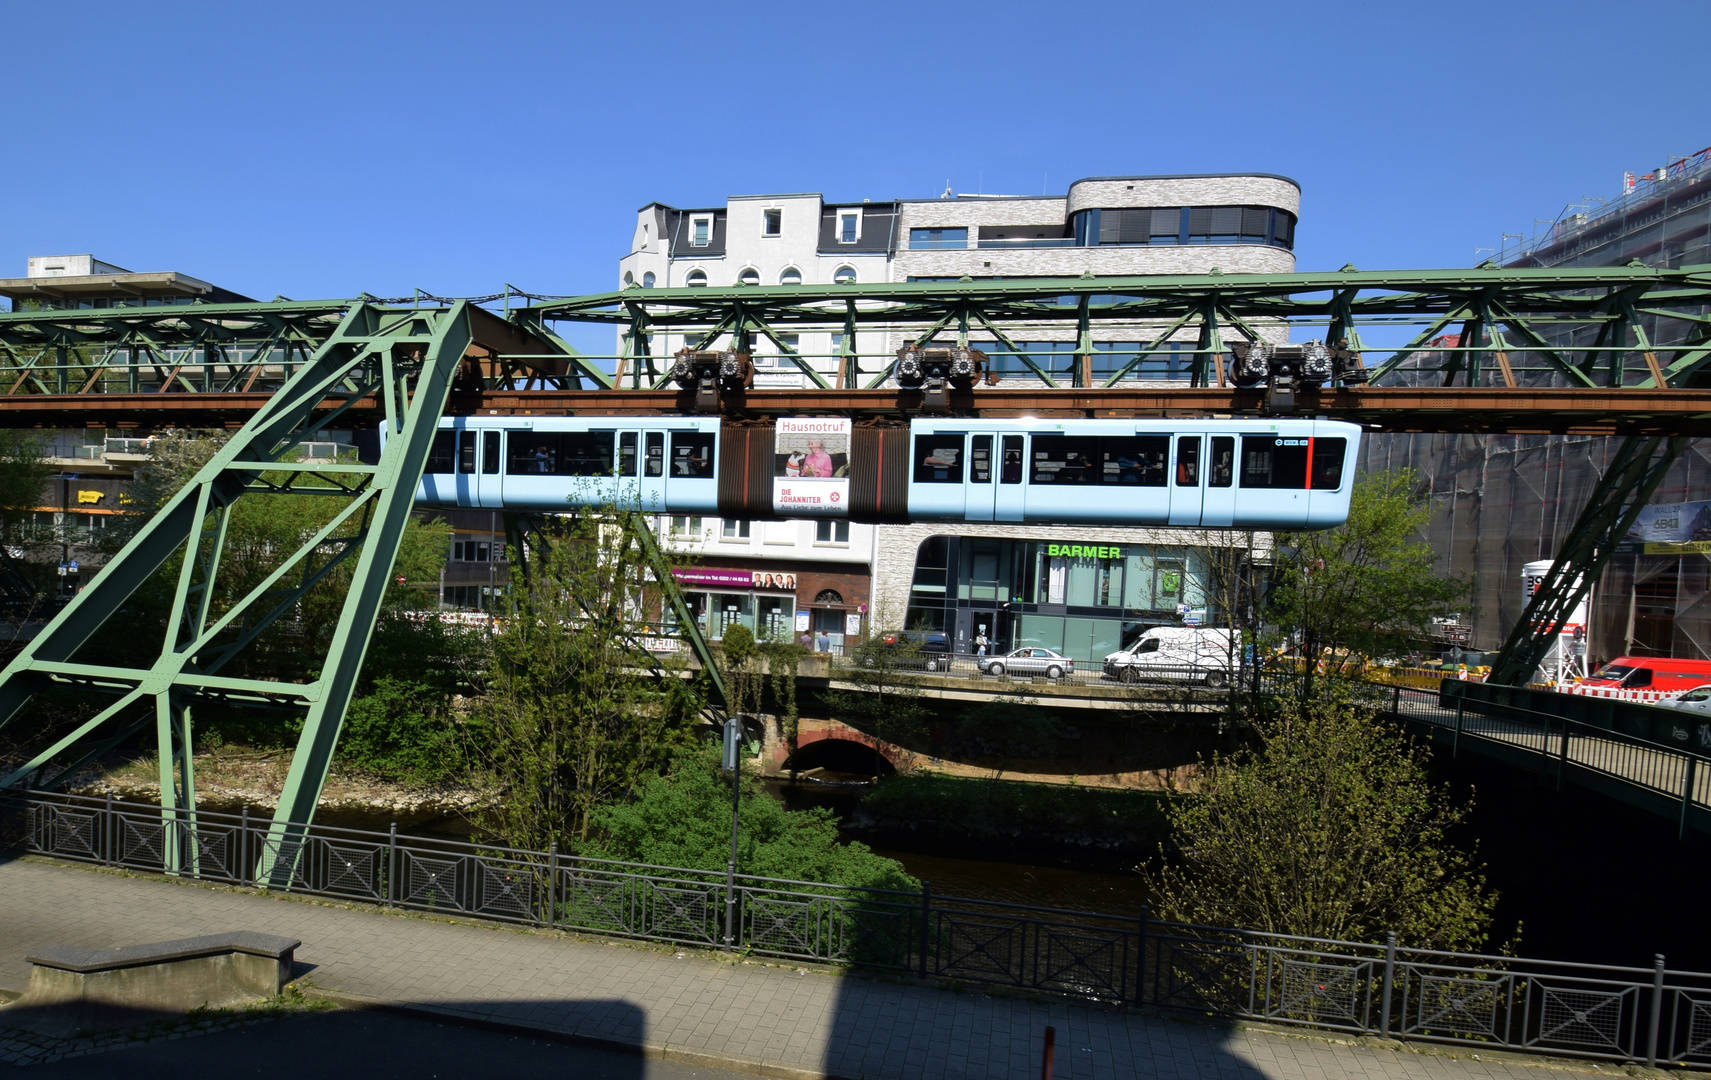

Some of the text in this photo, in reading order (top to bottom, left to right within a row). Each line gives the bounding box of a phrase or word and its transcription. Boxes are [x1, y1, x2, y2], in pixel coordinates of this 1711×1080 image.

[782, 421, 845, 432] Hausnotruf
[780, 495, 821, 503] JOHANNITER
[1048, 544, 1121, 559] BARMER
